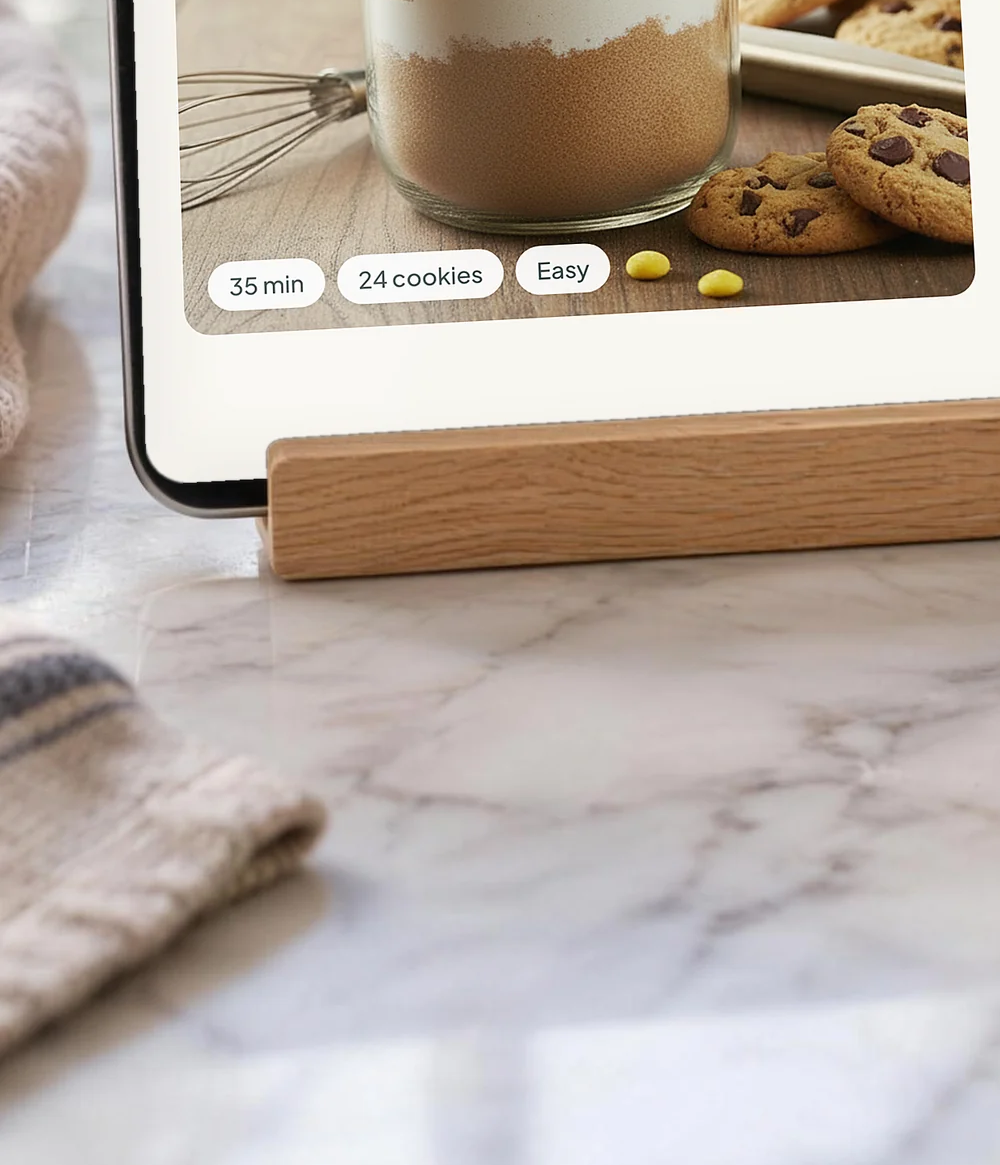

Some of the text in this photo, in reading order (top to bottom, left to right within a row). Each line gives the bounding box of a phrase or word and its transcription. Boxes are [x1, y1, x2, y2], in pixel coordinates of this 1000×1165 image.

[358, 266, 483, 290] 24 cookies
[537, 261, 590, 284] Easy
[229, 274, 304, 297] 35 min
